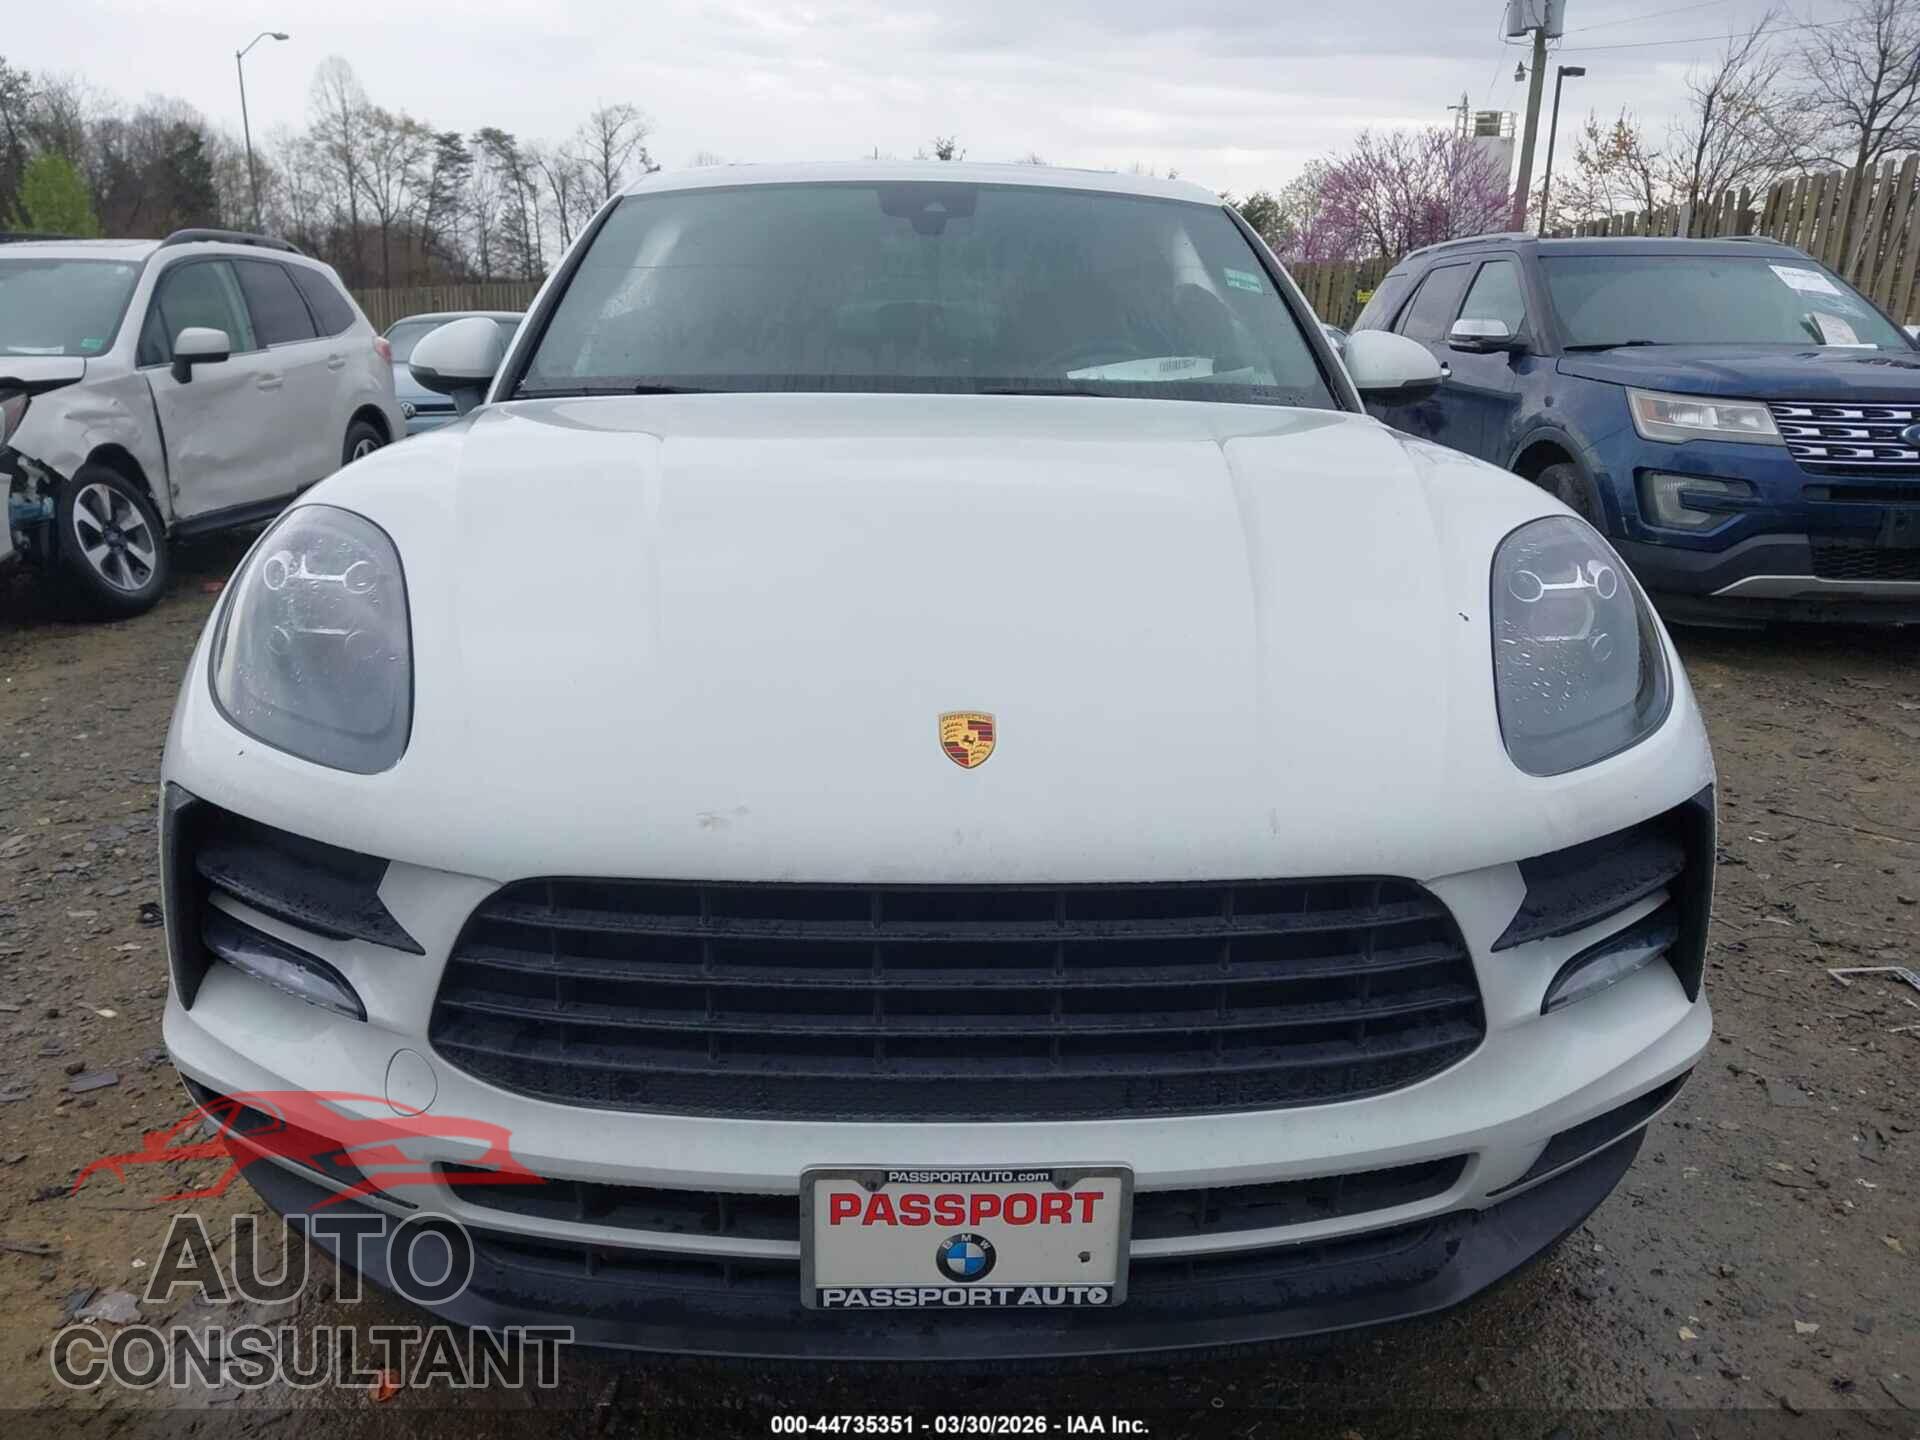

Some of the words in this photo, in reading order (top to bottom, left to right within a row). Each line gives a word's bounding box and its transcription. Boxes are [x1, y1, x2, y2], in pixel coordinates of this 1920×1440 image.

[888, 1171, 1050, 1184] PASSPORTAUTO.com
[829, 1191, 1104, 1227] PASSPORT
[942, 1234, 991, 1250] BMW
[823, 1288, 1013, 1308] PASSPORT
[1017, 1287, 1108, 1306] AUTO
